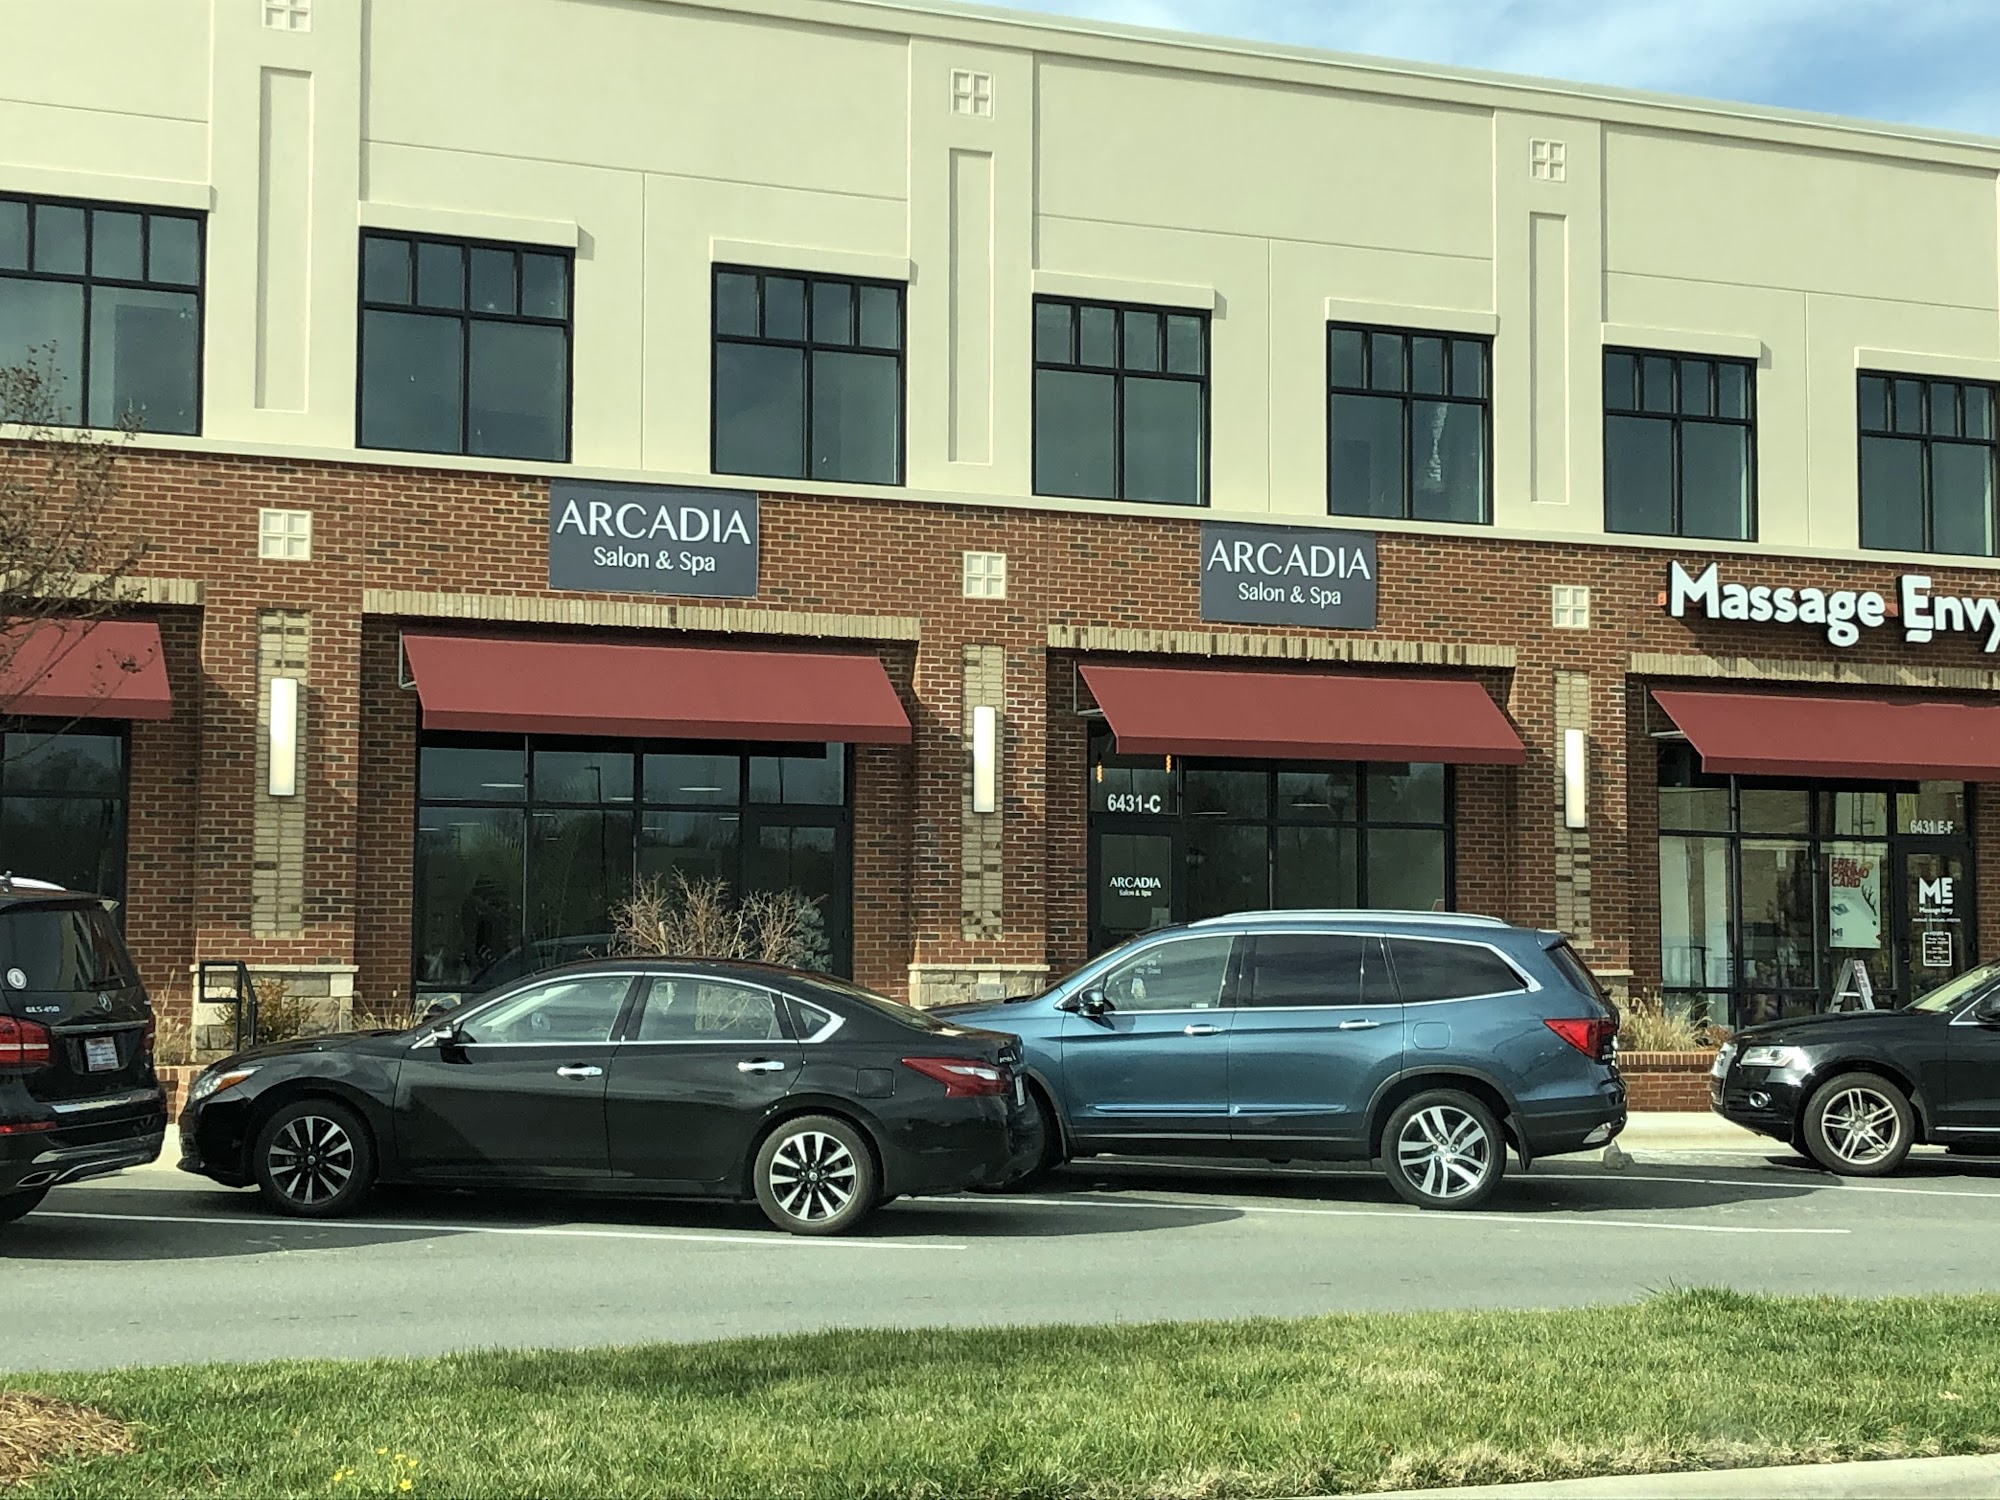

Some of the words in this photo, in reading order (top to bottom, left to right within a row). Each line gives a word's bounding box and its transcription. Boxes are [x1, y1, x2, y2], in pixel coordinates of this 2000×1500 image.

[556, 499, 752, 545] ARCADIA
[594, 545, 649, 569] Salon
[655, 550, 674, 570] &
[679, 551, 716, 576] Spa
[1206, 539, 1371, 580] ARCADIA
[1238, 581, 1285, 602] Salon
[1290, 585, 1306, 604] &
[1310, 586, 1342, 609] Spa
[1670, 559, 1885, 647] Massage
[1901, 574, 2000, 653] Envy
[1107, 793, 1162, 813] 6431-C
[1910, 819, 1934, 834] 6431
[1937, 820, 1954, 834] E-F
[1832, 857, 1857, 869] FREE
[1832, 866, 1870, 879] PROMO
[1109, 876, 1162, 889] ARCADIA
[1832, 877, 1861, 888] CARD
[1918, 877, 1953, 905] ME
[1119, 889, 1134, 897] Salon
[1141, 889, 1152, 898] Spa
